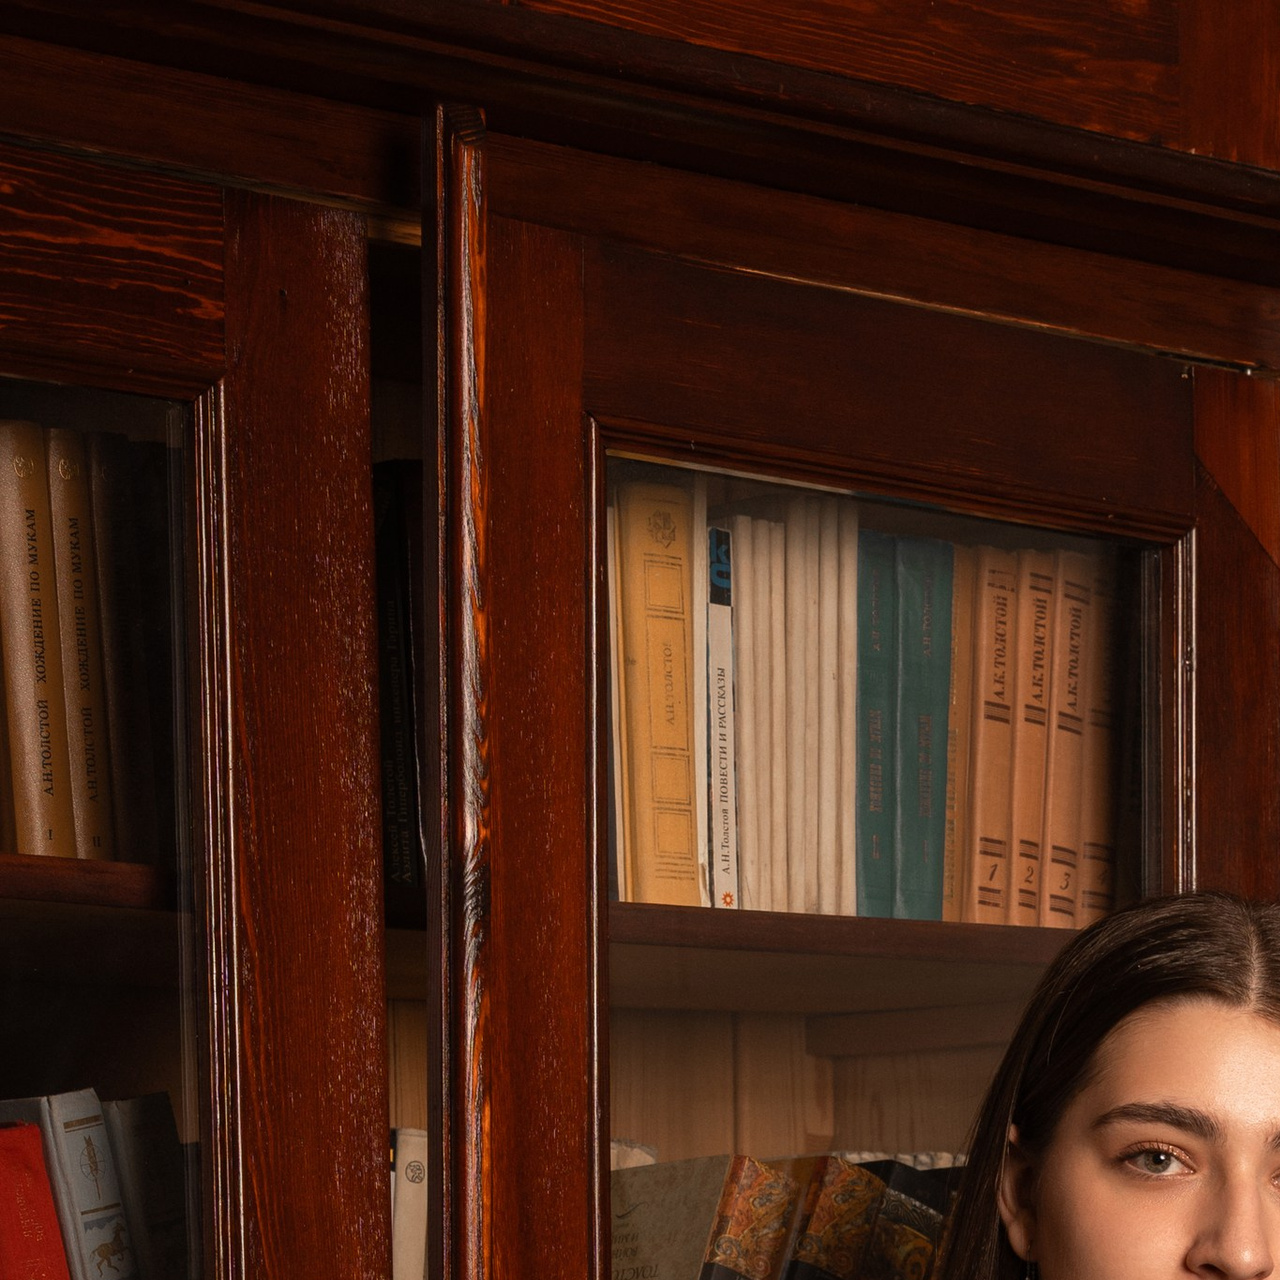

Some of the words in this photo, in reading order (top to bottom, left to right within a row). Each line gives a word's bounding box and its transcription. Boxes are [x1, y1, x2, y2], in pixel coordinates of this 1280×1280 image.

[25, 508, 39, 566] МУКАМ
[68, 516, 83, 573] МУКАМ
[28, 571, 41, 592] ПО
[72, 579, 86, 600] ПО
[30, 598, 47, 684] ХОЖДЕНИЕ
[74, 606, 91, 691] ХОЖДЕНИЕ
[717, 667, 727, 729] РАССКАЗЫ
[719, 733, 727, 742] И
[719, 746, 729, 803] ПОВЕСТИ
[988, 864, 998, 882] 1
[1024, 866, 1035, 884] 2
[1059, 873, 1072, 890] 3
